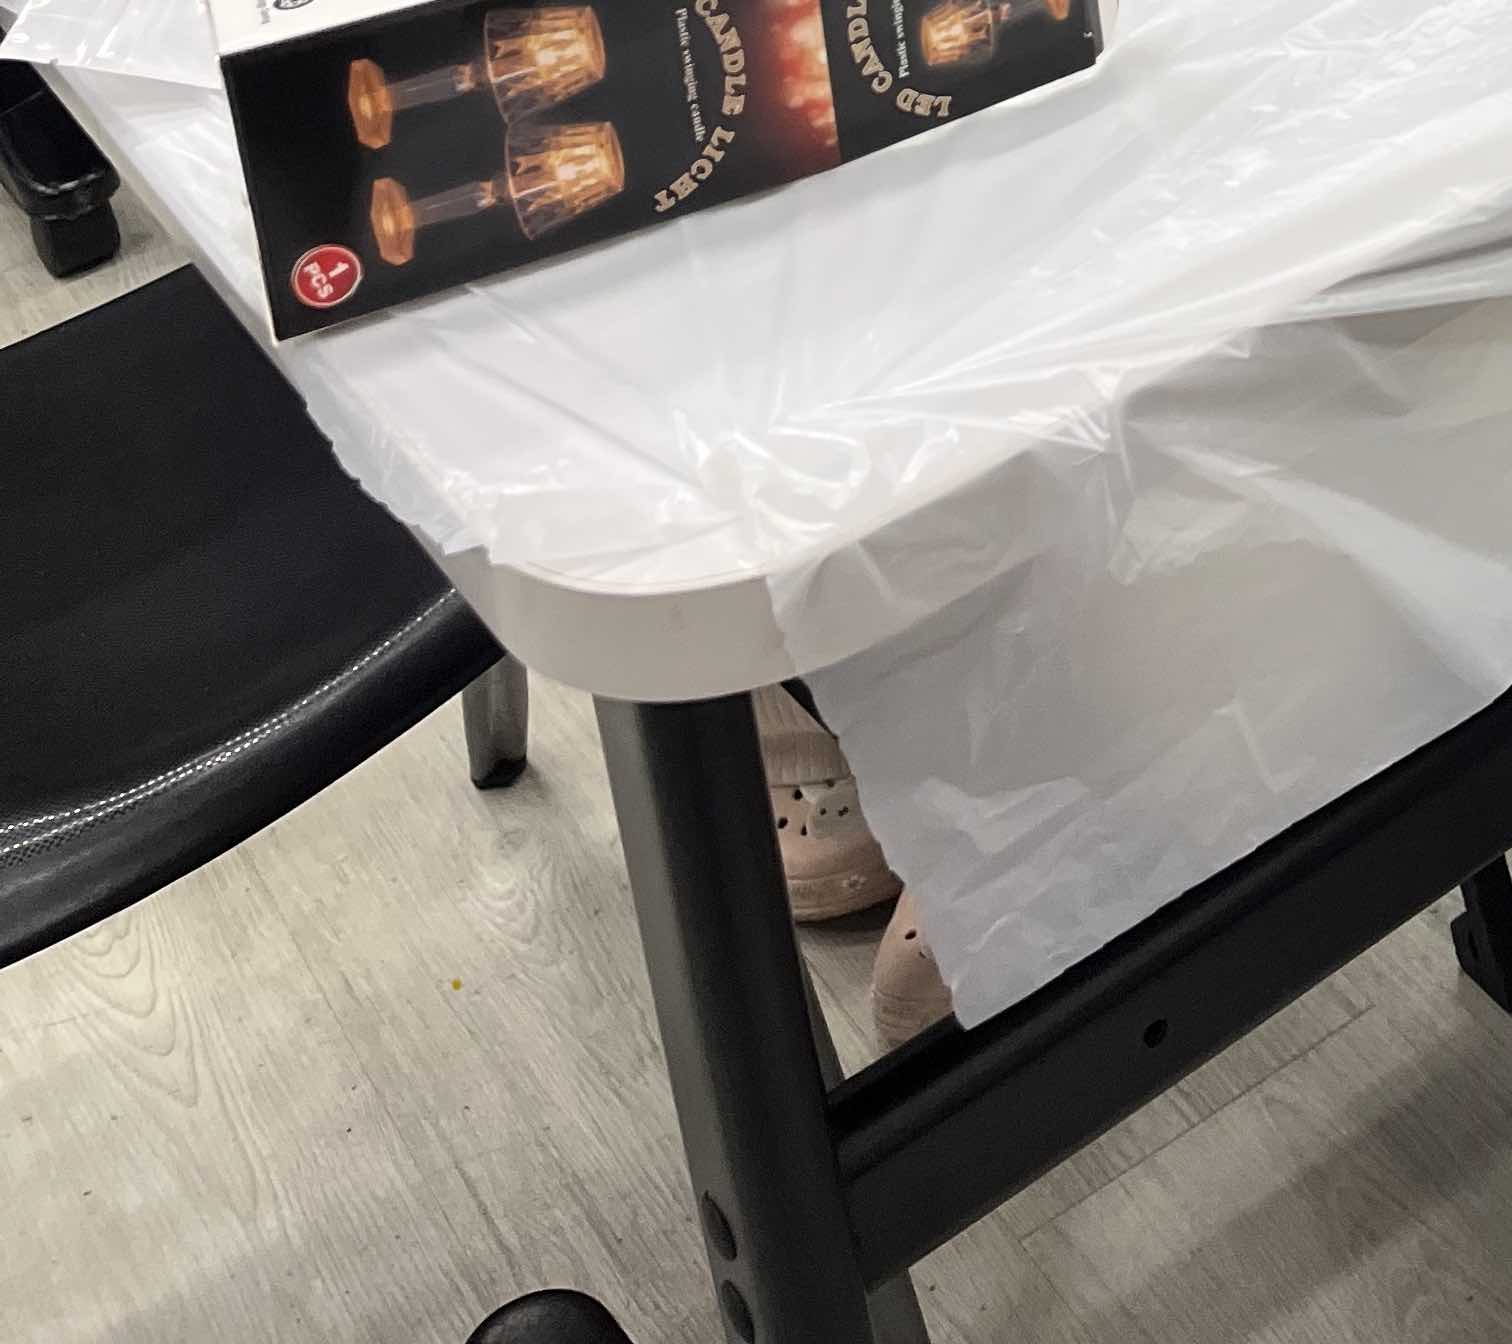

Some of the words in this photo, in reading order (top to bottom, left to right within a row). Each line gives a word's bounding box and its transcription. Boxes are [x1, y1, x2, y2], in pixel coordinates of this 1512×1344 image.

[898, 41, 910, 80] Plastic
[896, 88, 952, 118] LED
[303, 261, 334, 299] PCS
[328, 261, 350, 278] 1
